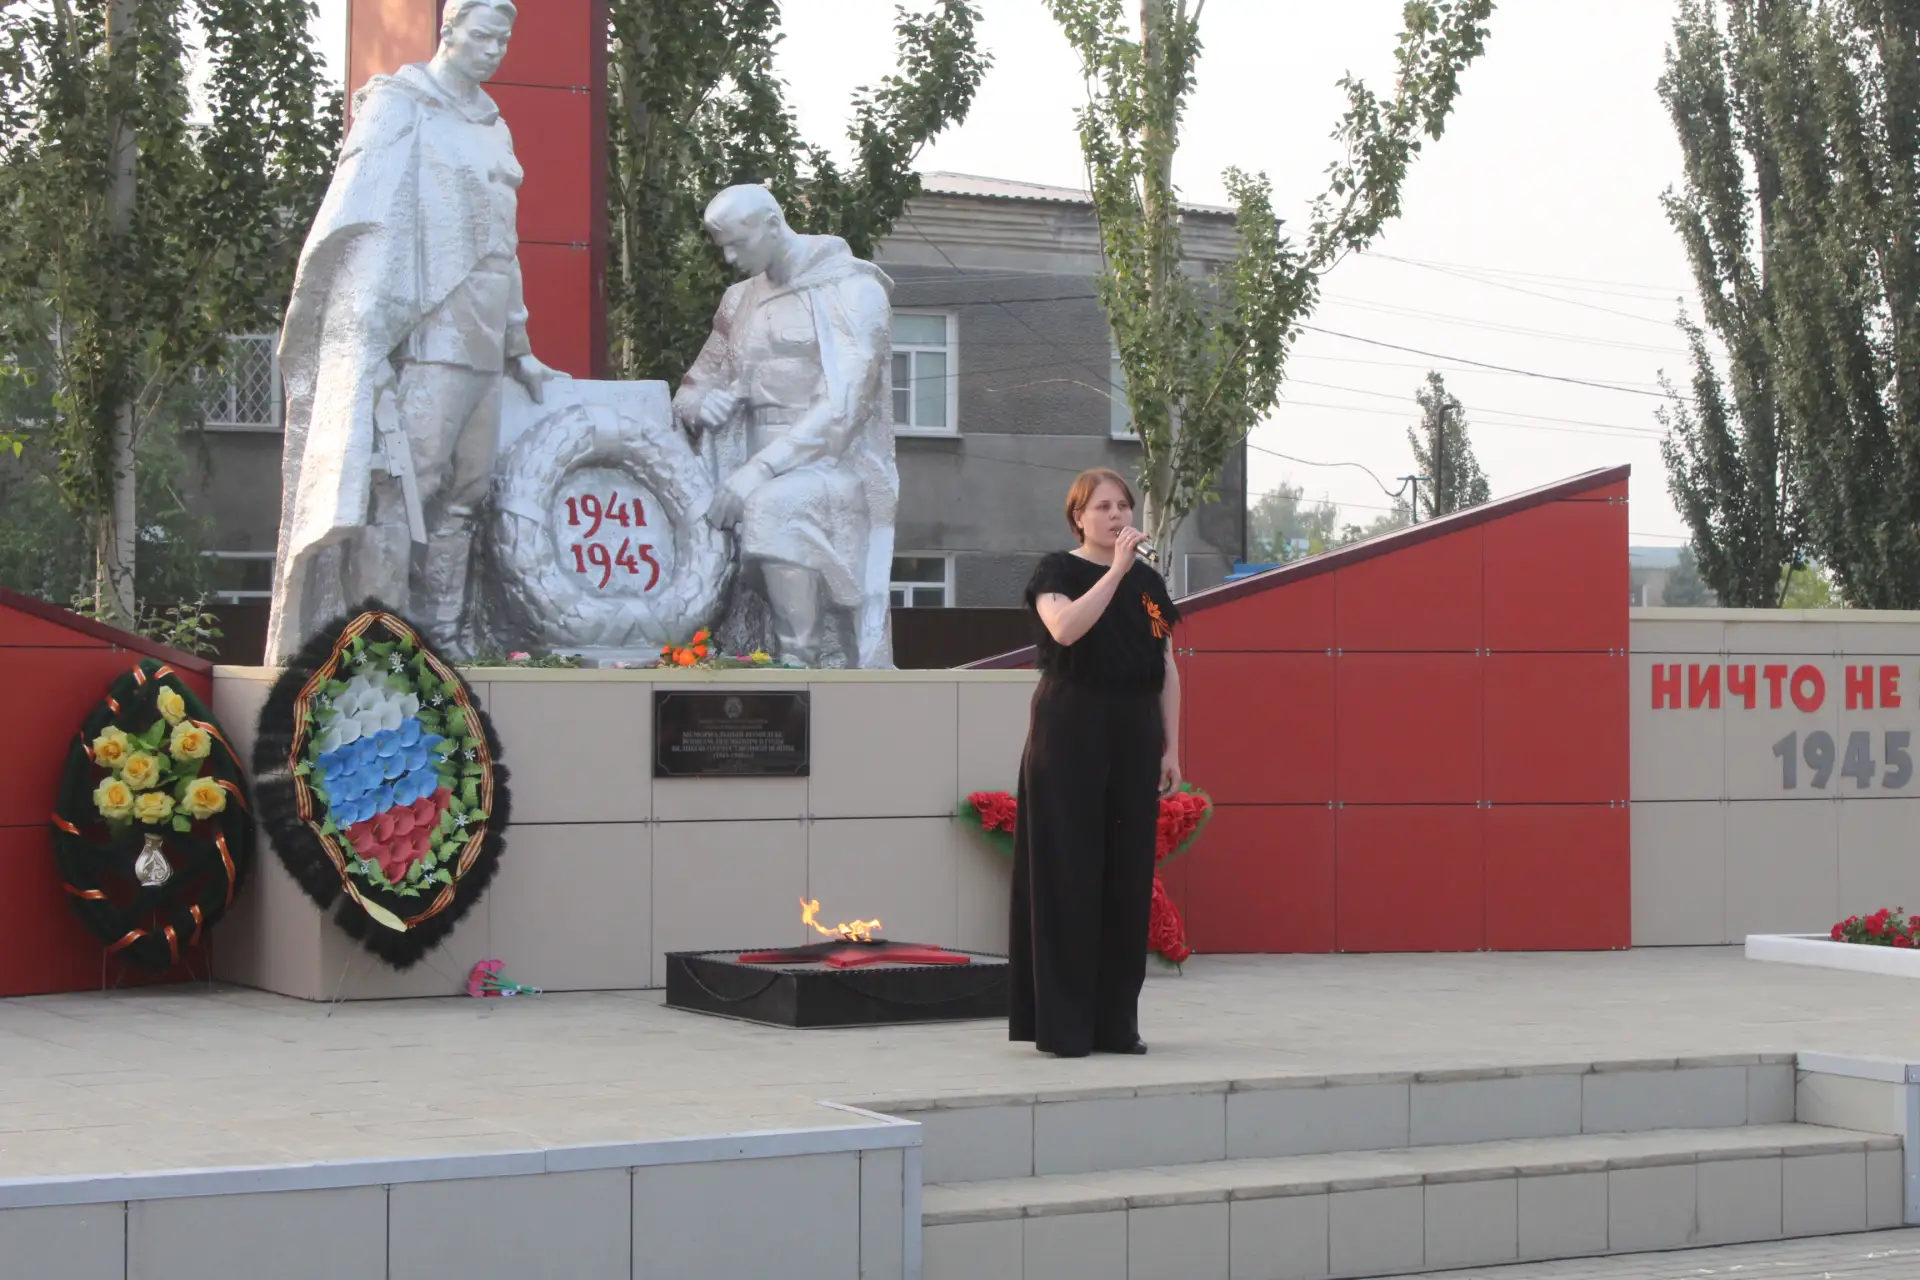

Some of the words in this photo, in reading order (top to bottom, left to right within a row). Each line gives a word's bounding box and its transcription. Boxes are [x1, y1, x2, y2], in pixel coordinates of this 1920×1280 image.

[564, 491, 648, 539] 1941
[571, 537, 660, 592] 1945
[1651, 663, 1826, 713] НИЧТО
[1845, 665, 1902, 710] НЕ
[1772, 730, 1914, 790] 1945
